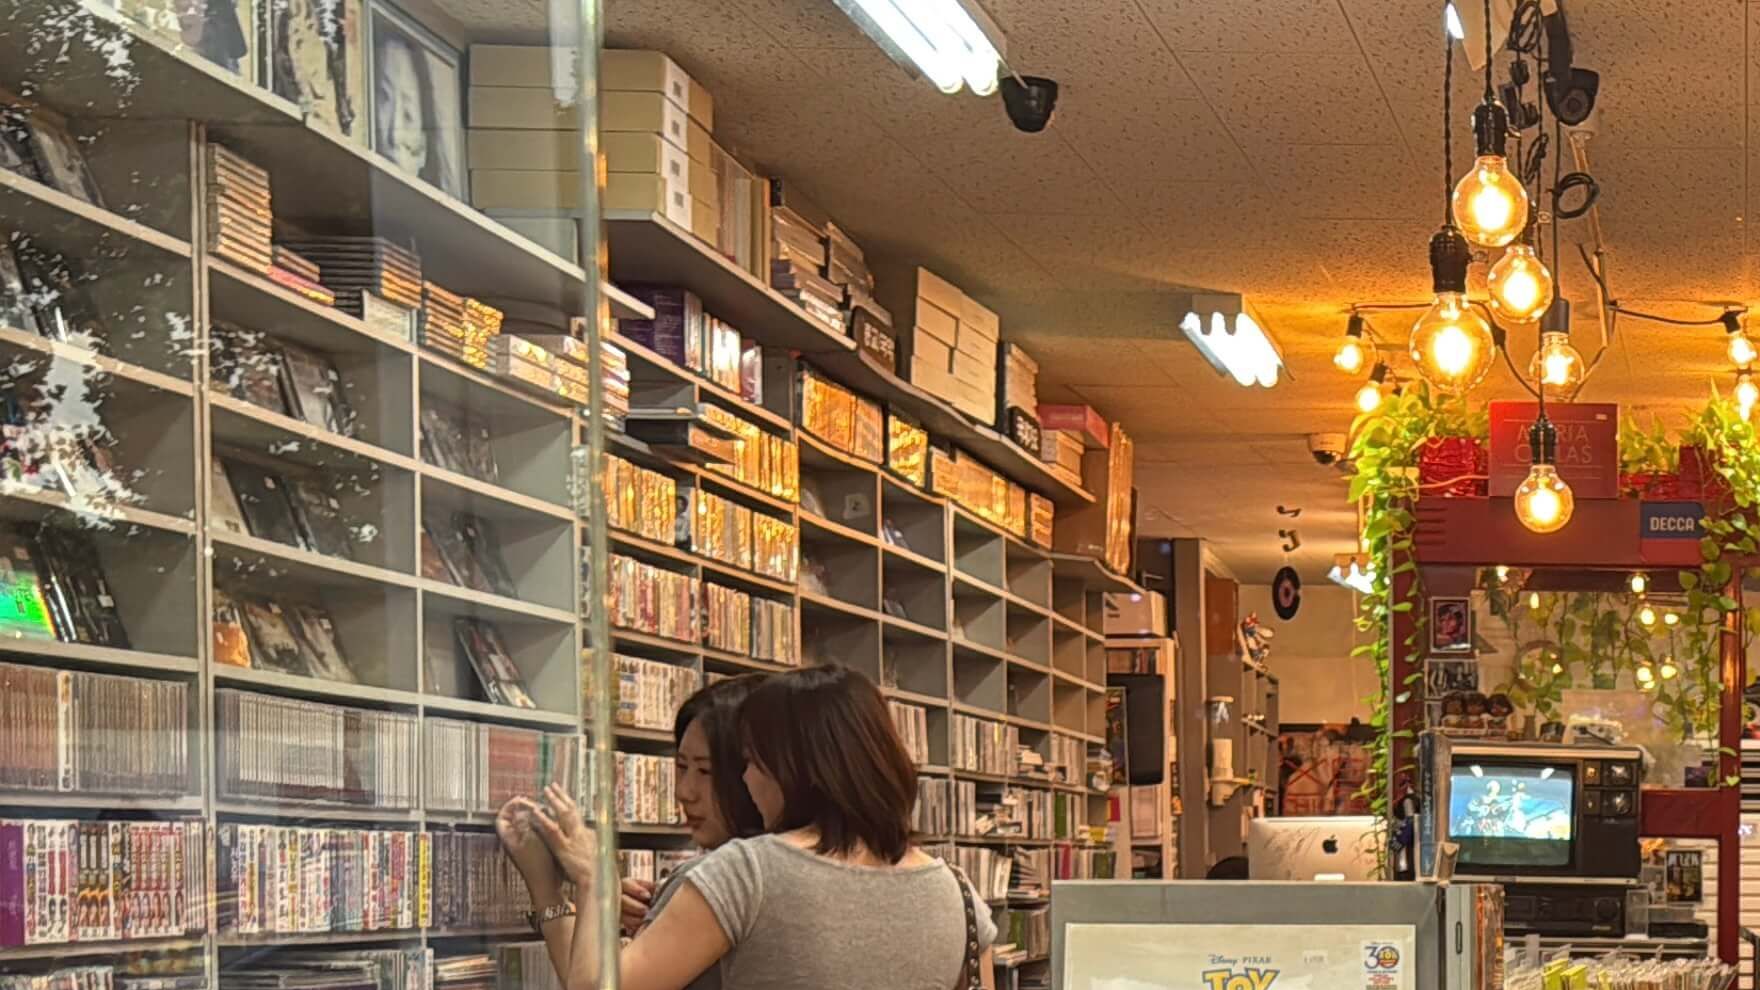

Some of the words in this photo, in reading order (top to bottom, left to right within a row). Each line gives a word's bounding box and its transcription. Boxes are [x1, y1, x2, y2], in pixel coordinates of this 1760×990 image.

[1517, 424, 1589, 442] MRIA
[1649, 516, 1695, 531] DECCA
[1208, 953, 1238, 966] Disney
[1242, 956, 1272, 964] PIXAR
